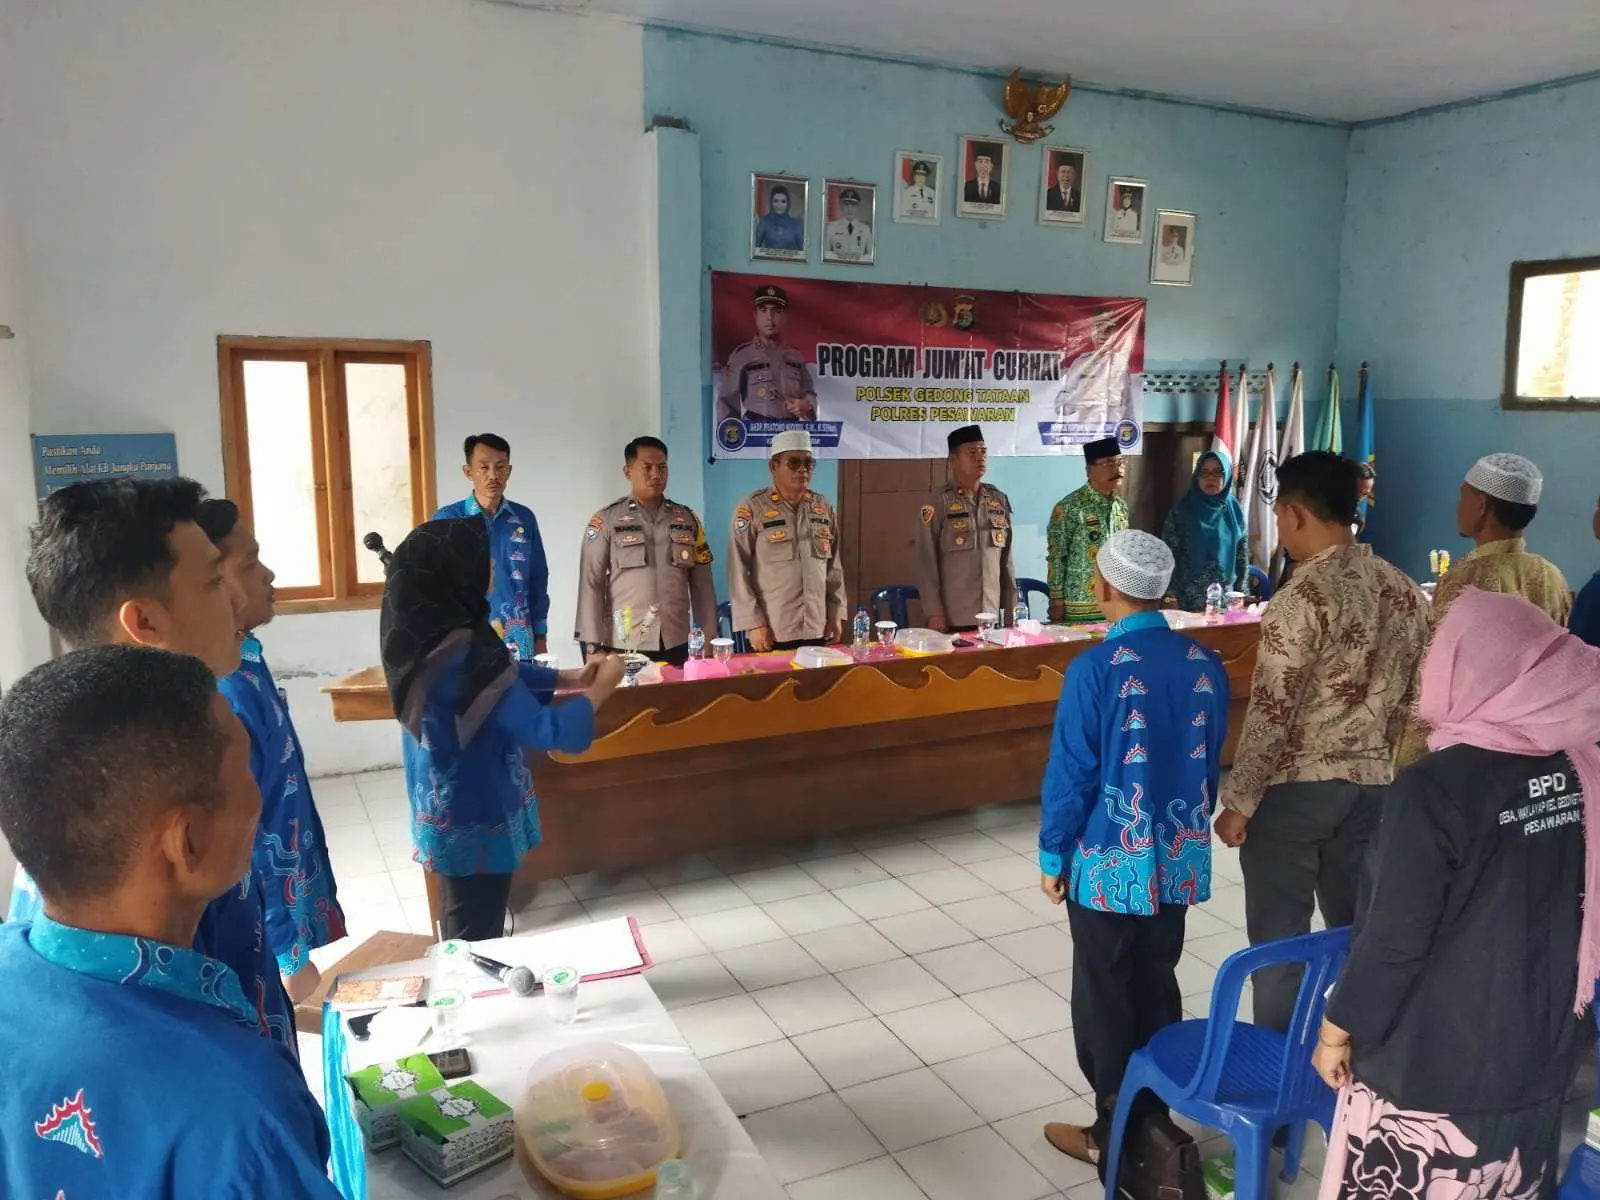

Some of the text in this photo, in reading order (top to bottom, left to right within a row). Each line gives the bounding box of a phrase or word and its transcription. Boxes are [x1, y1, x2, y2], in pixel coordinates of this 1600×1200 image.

[817, 344, 1063, 381] PROGRAM JUM'AT CURHAT
[856, 386, 1030, 403] POLSEK GEDONG TATAAN
[870, 407, 1016, 422] POLRES PESAWARAN
[1528, 772, 1567, 798] BPD
[1523, 810, 1580, 836] PESAWARAN
